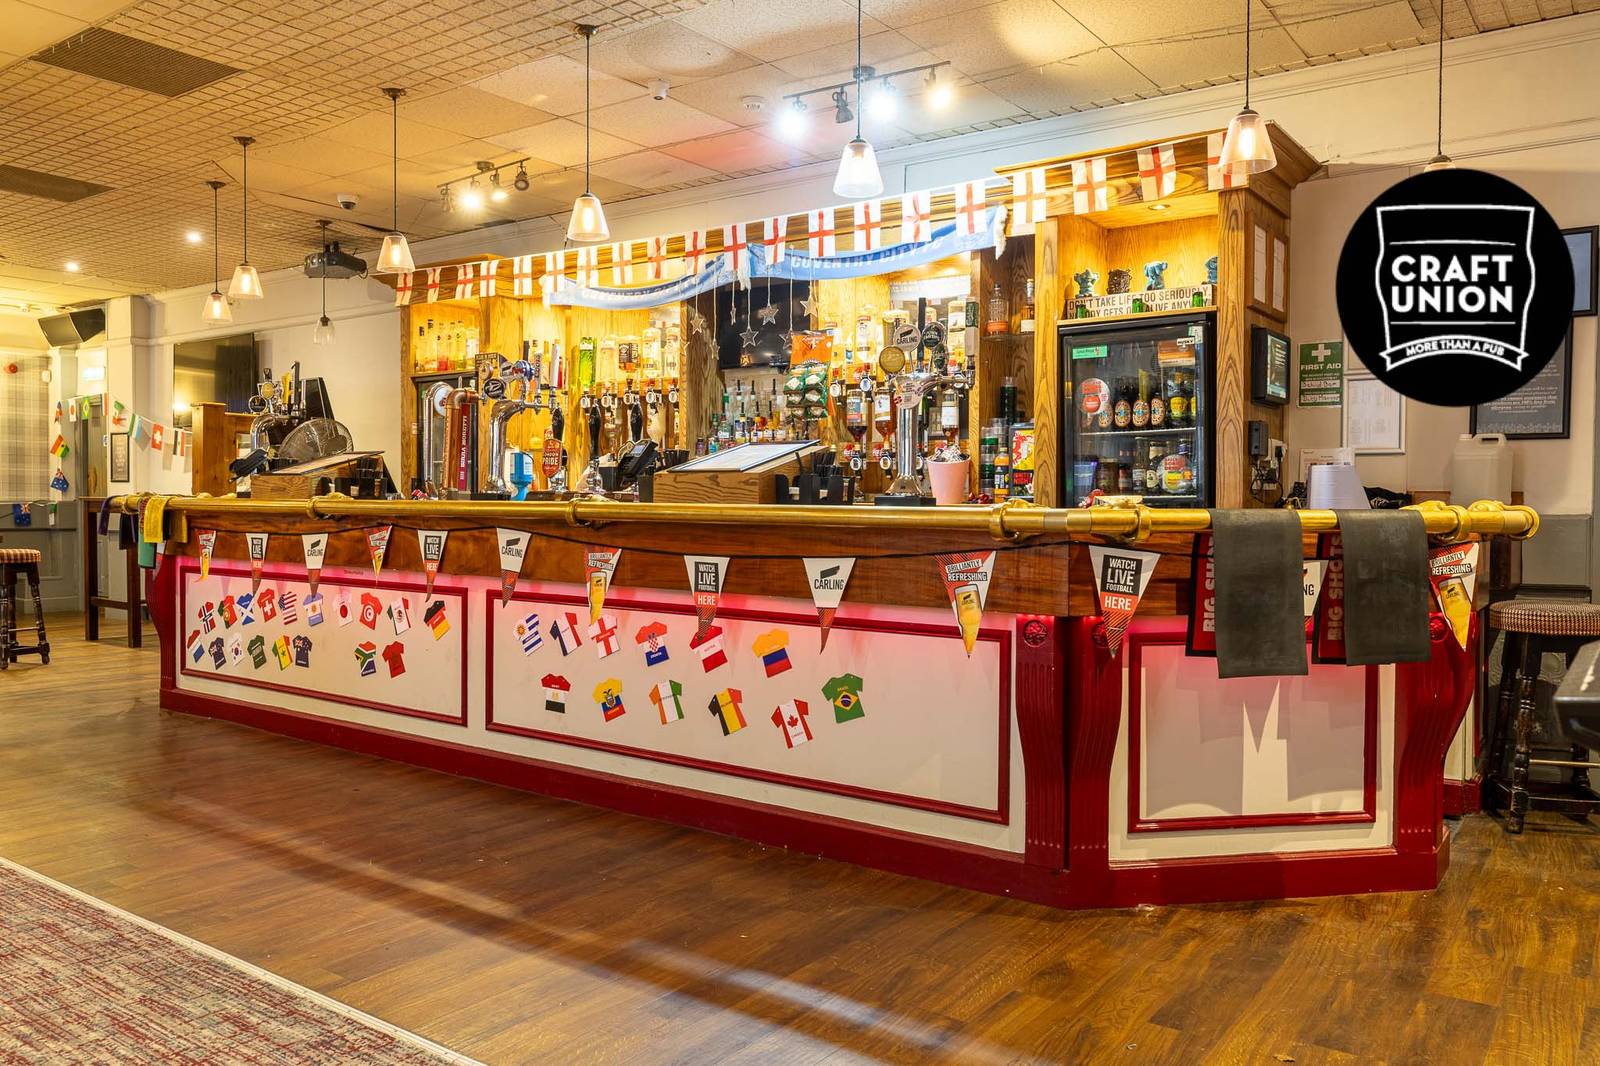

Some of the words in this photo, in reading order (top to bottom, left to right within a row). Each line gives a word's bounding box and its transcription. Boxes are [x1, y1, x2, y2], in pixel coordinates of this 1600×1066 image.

[1096, 297, 1116, 307] TAKE
[1104, 306, 1123, 317] GETS
[896, 335, 919, 345] CARLING
[1301, 363, 1324, 371] FIRST
[1326, 362, 1342, 370] AID
[543, 457, 559, 465] PRIDE
[426, 544, 440, 555] LIVE
[501, 547, 523, 559] CARLING
[1109, 558, 1137, 570] WATCH
[1430, 552, 1464, 567] BRILLIANTLY
[698, 564, 716, 573] WATCH
[946, 560, 981, 573] BRILLIANTLY
[1328, 535, 1344, 600] SHOTS
[1432, 564, 1472, 575] REFRESHING
[698, 573, 716, 585] LIVE
[947, 572, 987, 582] REFRESHING
[1107, 568, 1136, 586] LIVE
[814, 578, 845, 590] CARLING
[1106, 583, 1134, 593] FOOTBALL
[697, 594, 716, 606] HERE
[1104, 596, 1132, 611] HERE
[1203, 597, 1216, 632] BIG
[1327, 605, 1343, 641] BIG
